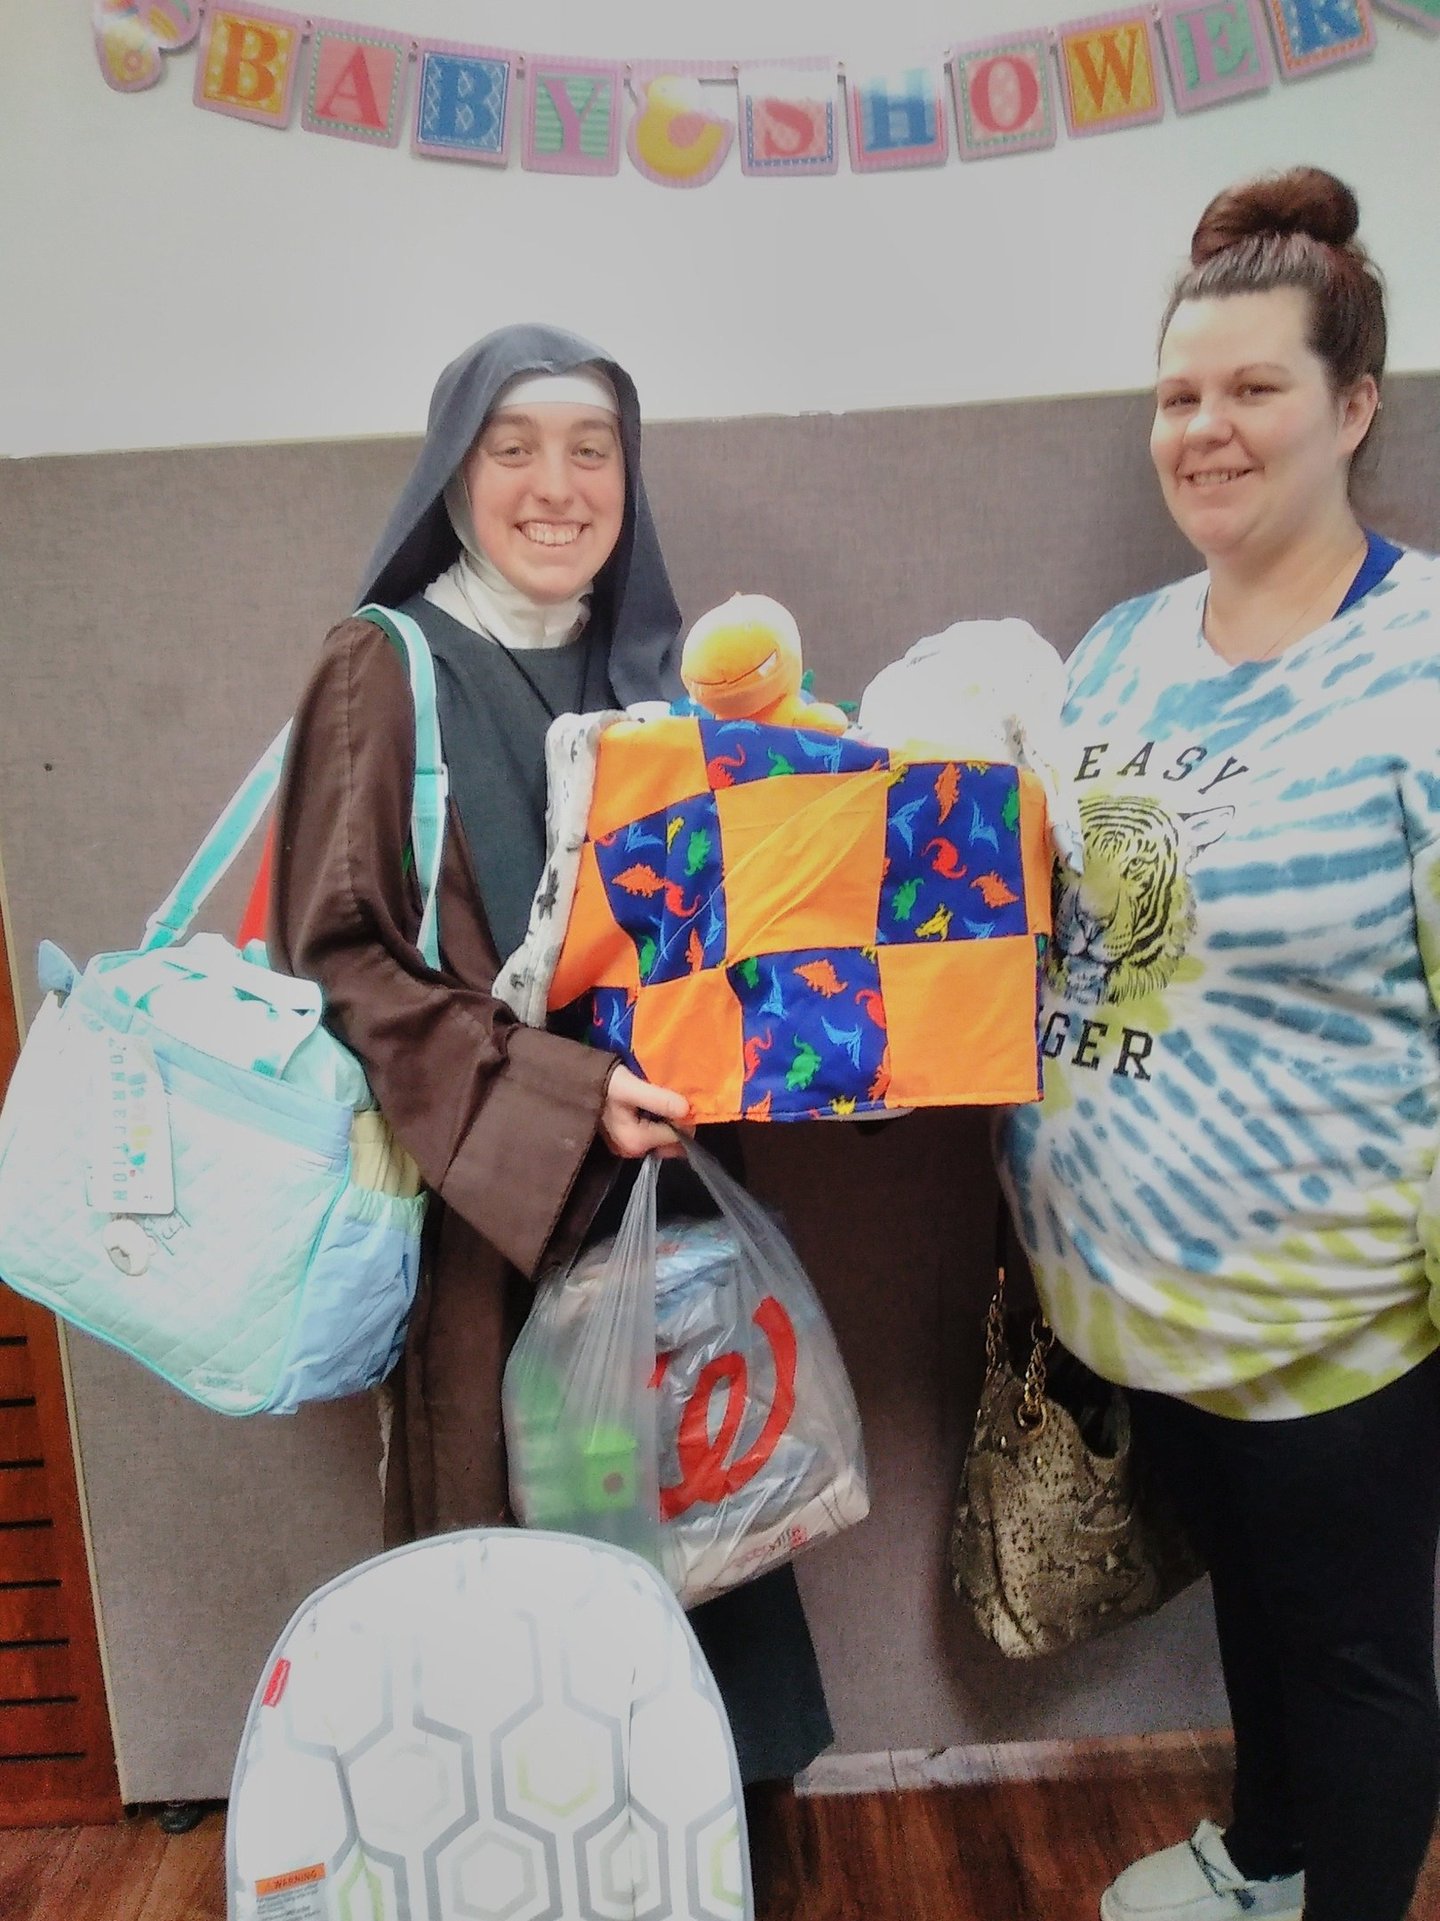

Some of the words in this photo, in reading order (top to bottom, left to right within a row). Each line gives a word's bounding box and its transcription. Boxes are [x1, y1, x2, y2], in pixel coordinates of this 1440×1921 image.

[217, 20, 612, 158] BABY
[763, 0, 1362, 158] SHOWER
[1073, 740, 1249, 795] EASY
[1040, 1006, 1153, 1081] GER
